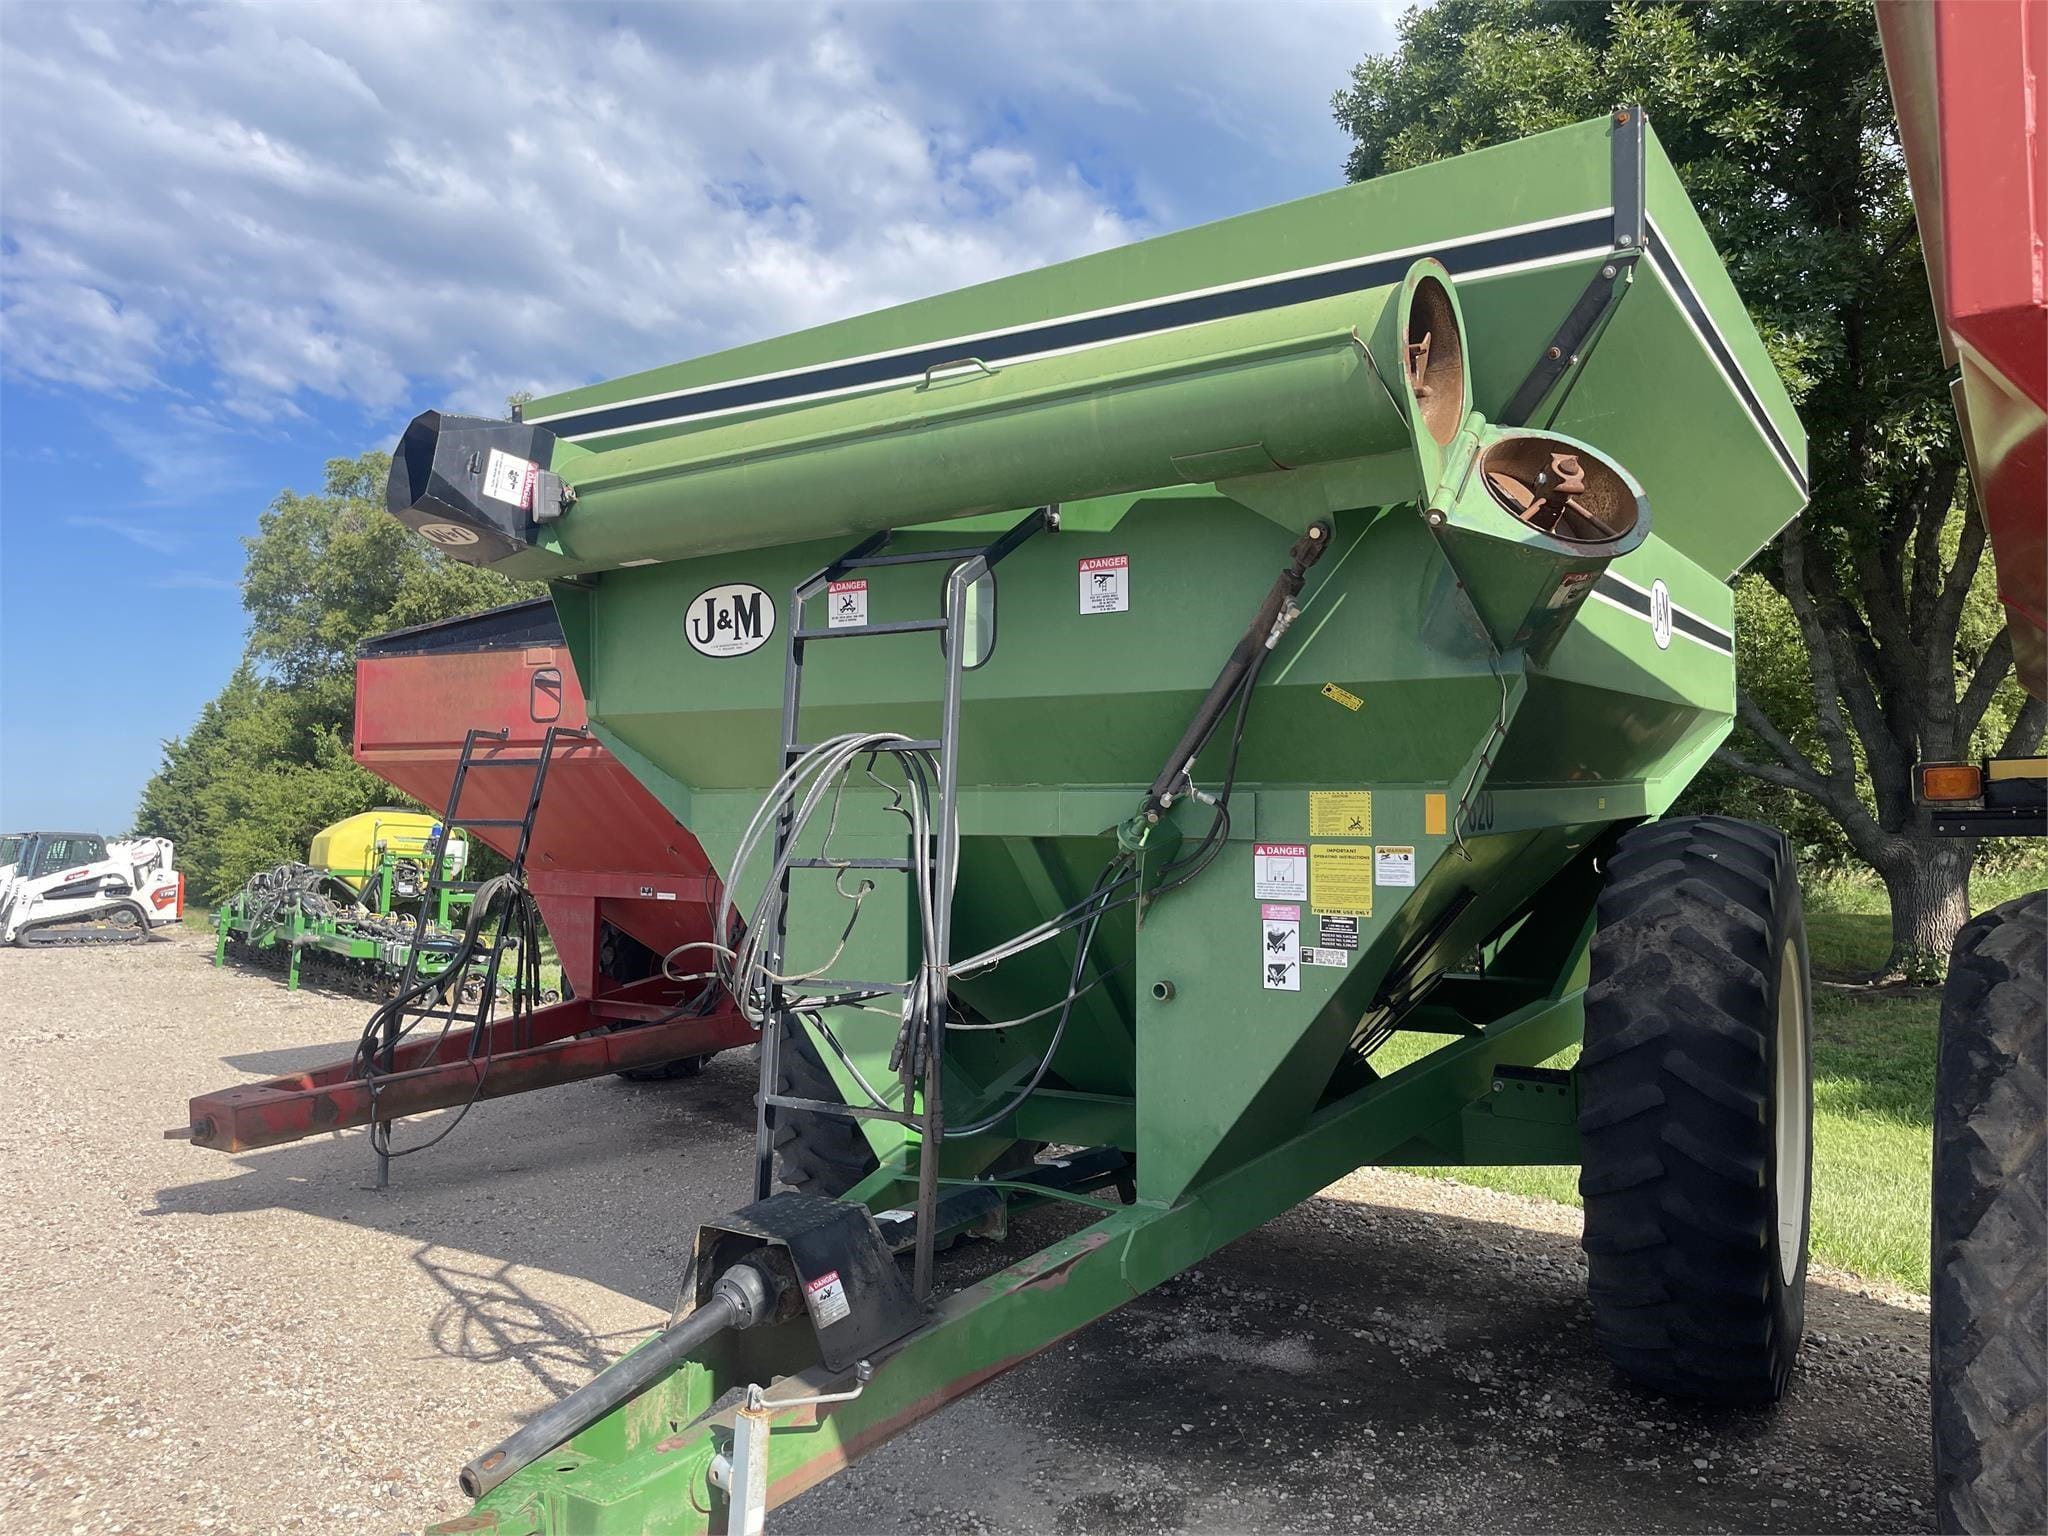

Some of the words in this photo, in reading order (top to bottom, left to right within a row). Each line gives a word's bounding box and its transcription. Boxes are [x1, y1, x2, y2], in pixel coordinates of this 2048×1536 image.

[521, 471, 536, 507] DANGER
[424, 528, 472, 542] J&M
[1089, 557, 1127, 569] DANGER
[836, 580, 867, 590] DANGER
[693, 592, 764, 644] J&M
[1266, 846, 1305, 856] DANGER
[813, 1273, 837, 1289] DANGER
